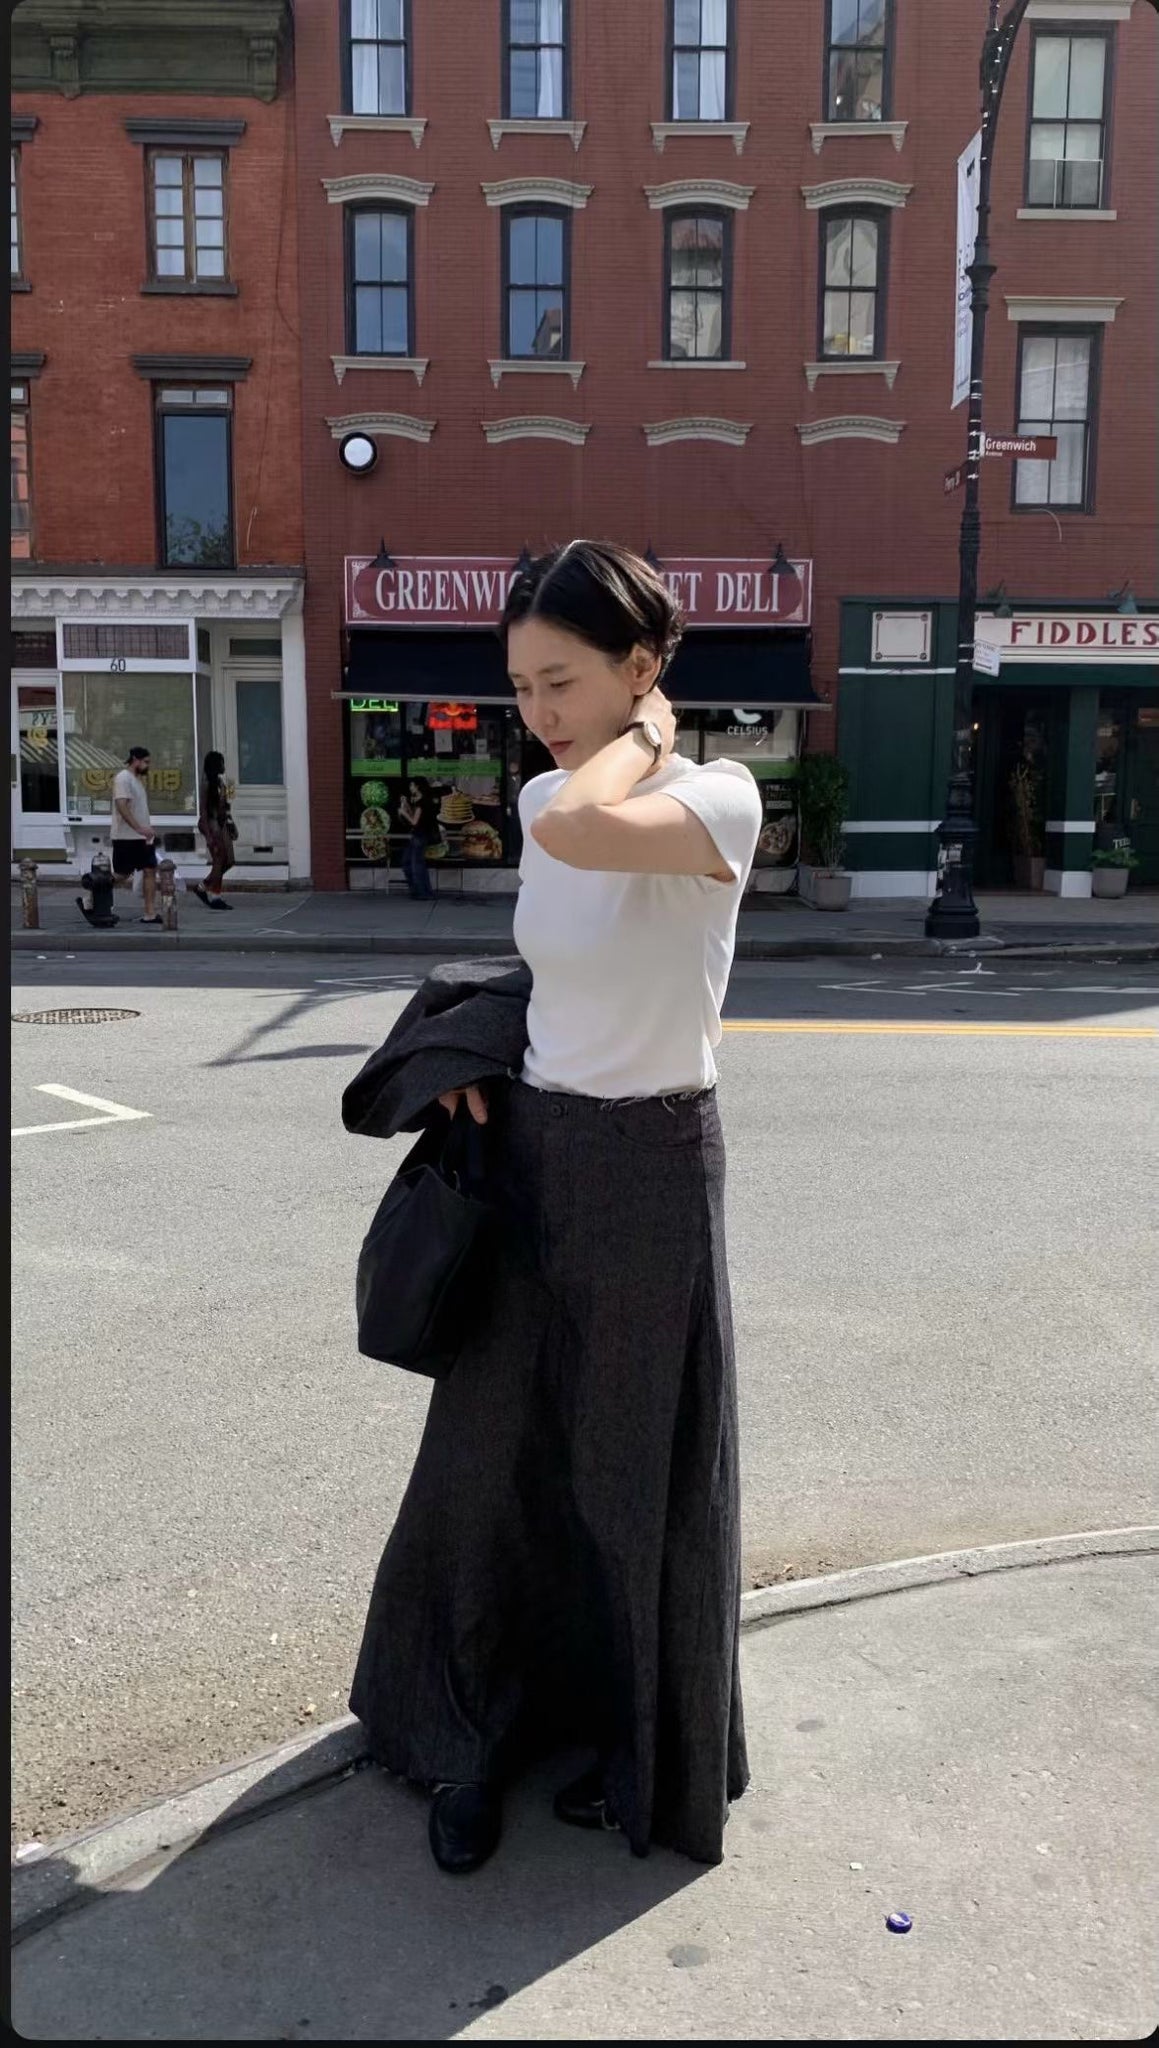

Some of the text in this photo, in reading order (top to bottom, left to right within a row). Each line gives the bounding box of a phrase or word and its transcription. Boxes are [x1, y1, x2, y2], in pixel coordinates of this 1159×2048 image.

[985, 438, 1036, 452] Greenwich
[661, 572, 702, 612] ET
[716, 572, 780, 613] DELI
[1010, 621, 1159, 646] FIDDLES
[110, 659, 126, 672] 60
[727, 726, 768, 736] CELSIUS
